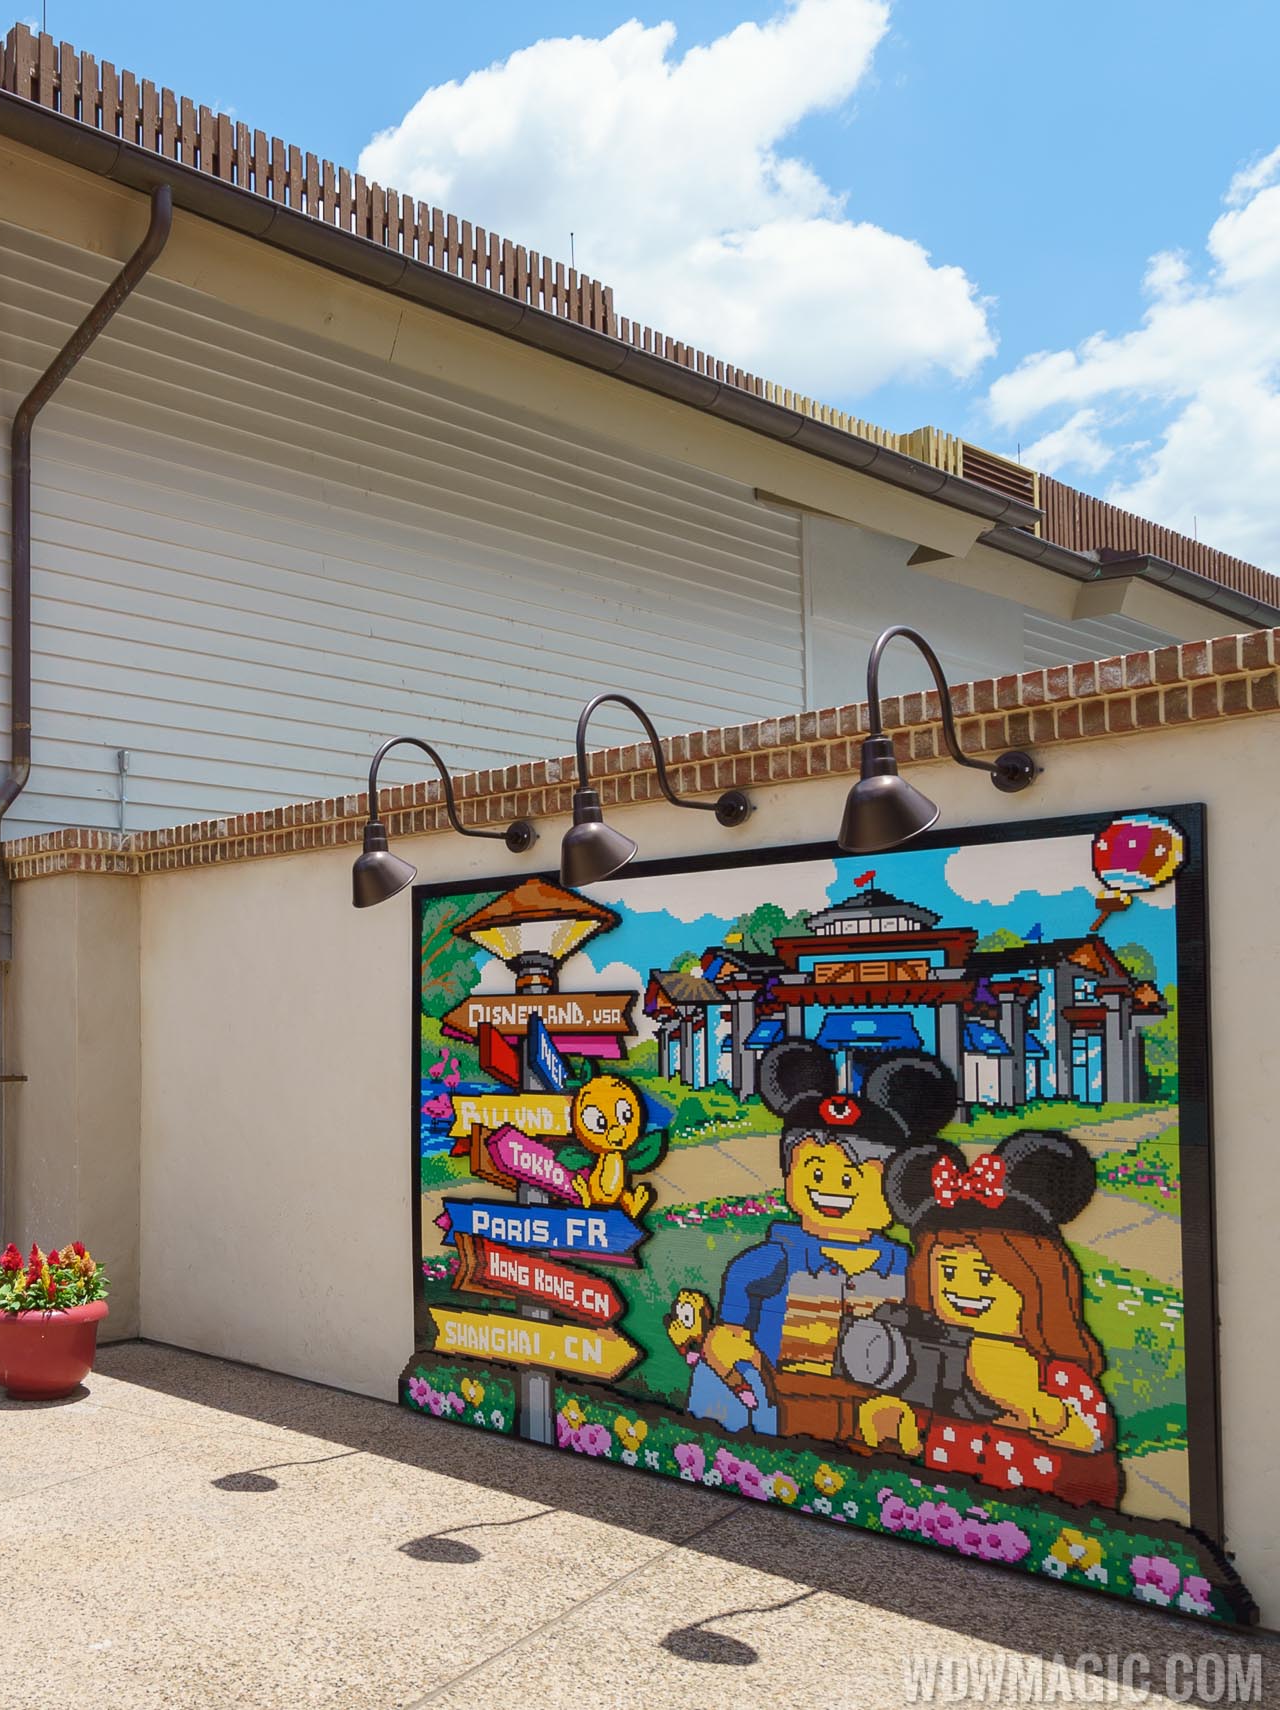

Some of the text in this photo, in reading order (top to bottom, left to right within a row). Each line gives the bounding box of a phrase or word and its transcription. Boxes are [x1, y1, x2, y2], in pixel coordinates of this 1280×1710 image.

[471, 1209, 609, 1248] PARIS, FR
[489, 1252, 530, 1287] HONG
[581, 1288, 610, 1318] CN
[563, 1335, 603, 1365] CN
